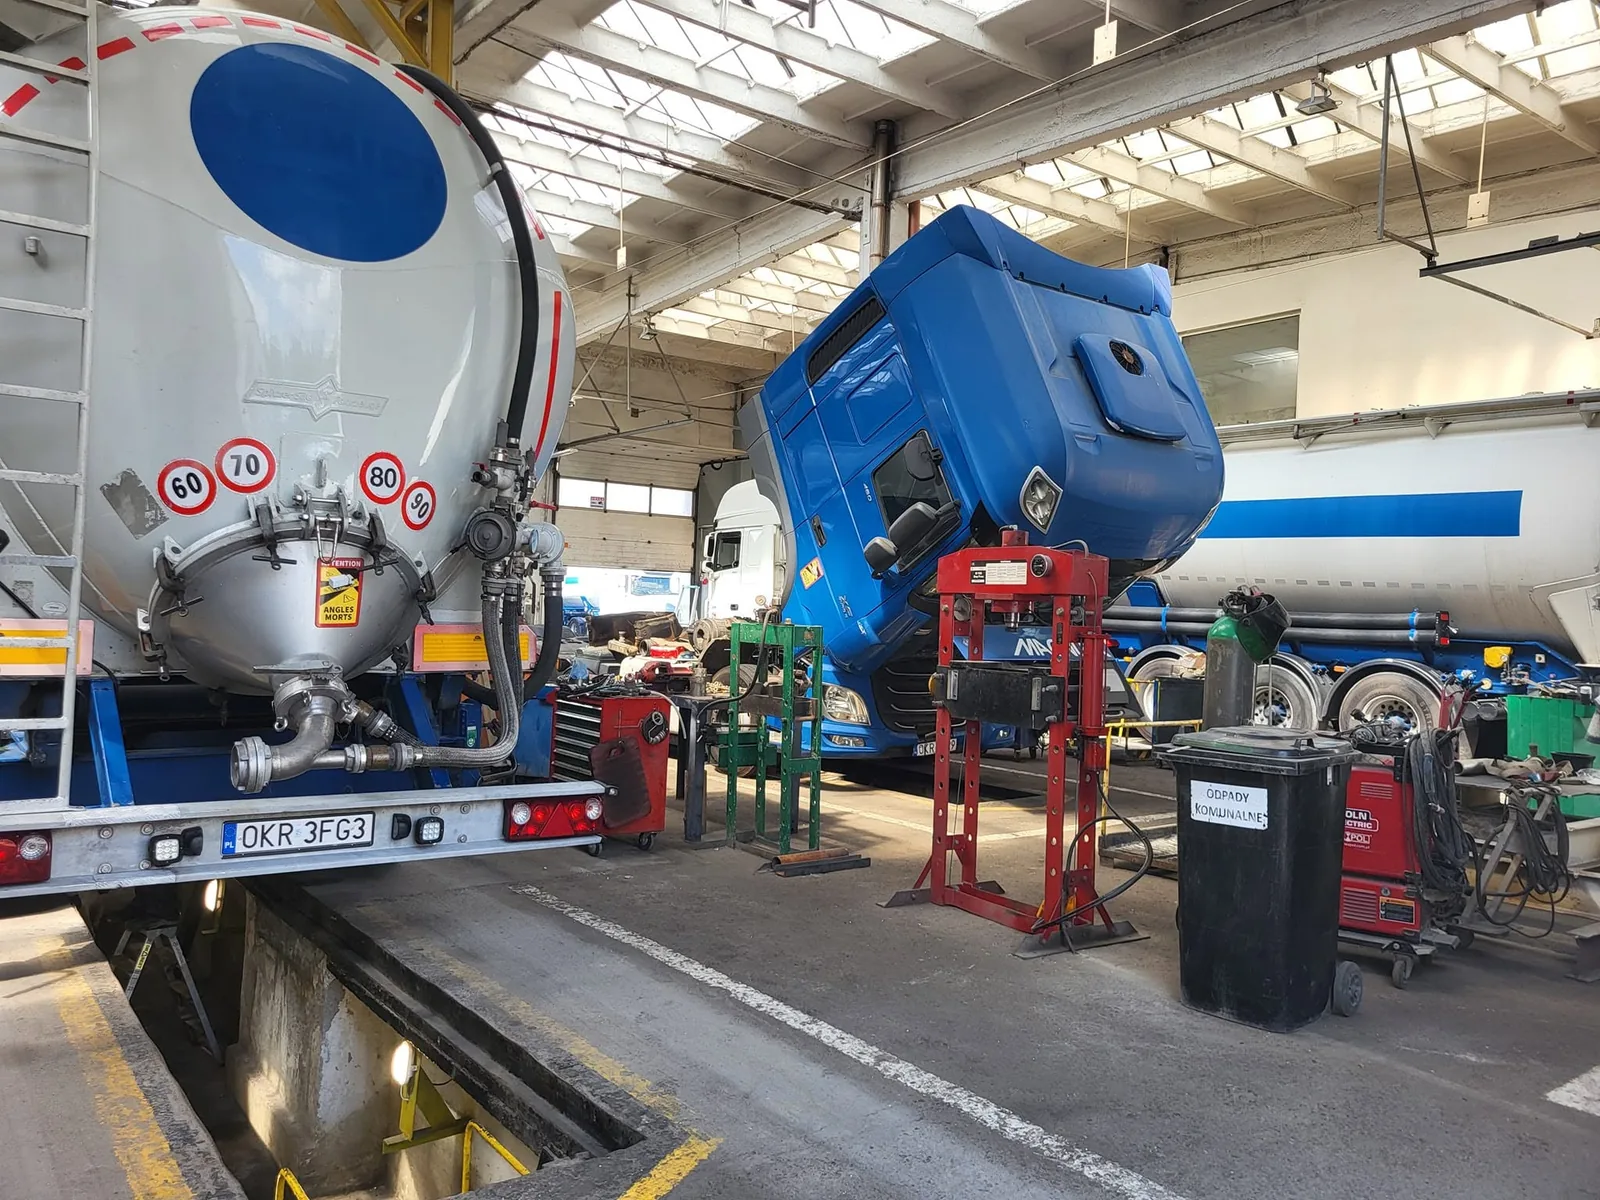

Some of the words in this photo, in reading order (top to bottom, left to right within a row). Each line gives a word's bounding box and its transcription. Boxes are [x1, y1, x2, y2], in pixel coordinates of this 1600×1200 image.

[230, 454, 260, 476] 70
[172, 472, 202, 499] 60
[370, 467, 397, 488] 80
[411, 493, 429, 518] 90
[324, 606, 354, 614] ANGLES
[1206, 788, 1250, 803] ODPADY
[1195, 803, 1262, 823] KOMUNALNE
[1345, 810, 1367, 820] OLN
[242, 823, 293, 848] OKR
[304, 817, 366, 844] 3FG3
